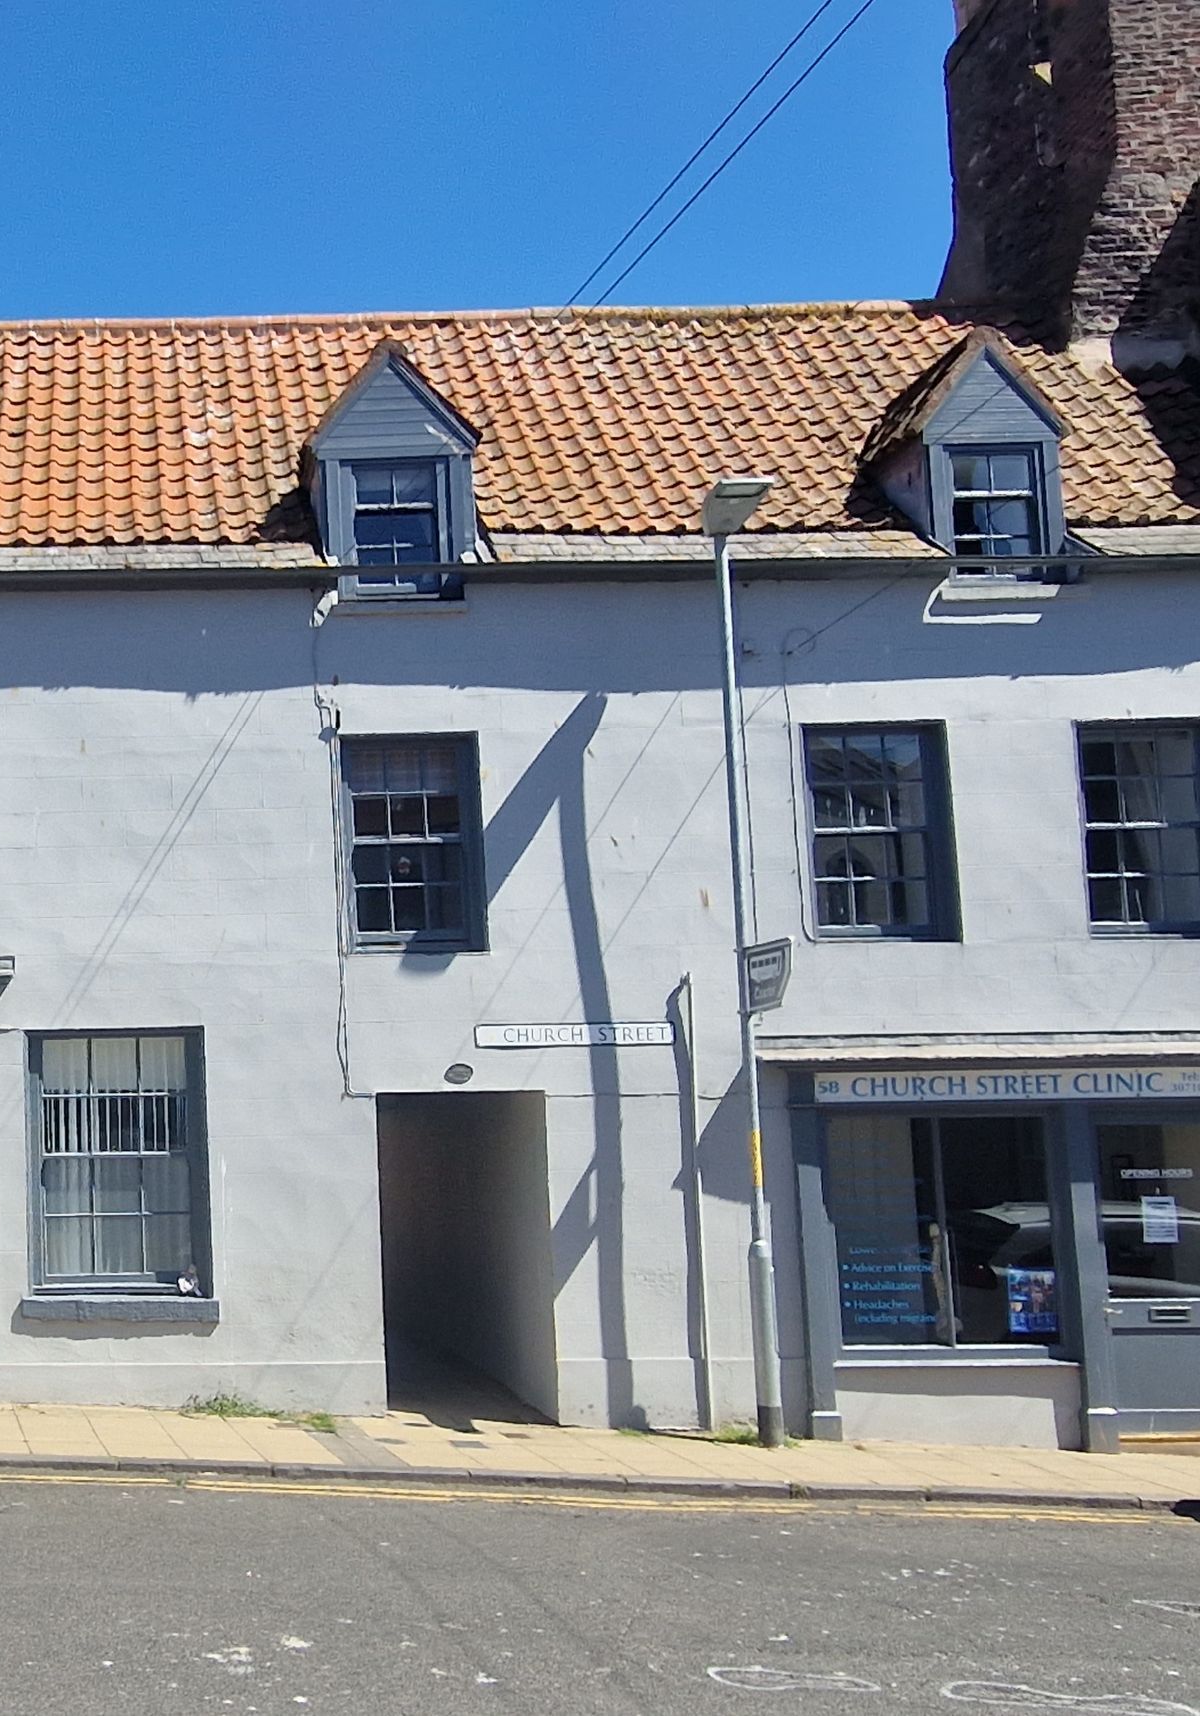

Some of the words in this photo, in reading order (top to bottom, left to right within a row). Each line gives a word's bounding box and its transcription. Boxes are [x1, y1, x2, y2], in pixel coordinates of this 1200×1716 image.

[503, 1026, 583, 1043] CHURCH
[598, 1026, 667, 1041] STREET
[818, 1081, 840, 1094] 58
[851, 1075, 967, 1097] CHURCH
[977, 1073, 1062, 1096] STREET
[1073, 1072, 1164, 1094] CLINIC
[1120, 1168, 1160, 1178] OPENING
[1161, 1168, 1193, 1178] HOURS
[851, 1262, 882, 1273] Advice
[852, 1281, 921, 1292] Rehabilitation
[853, 1299, 910, 1310] Headaches
